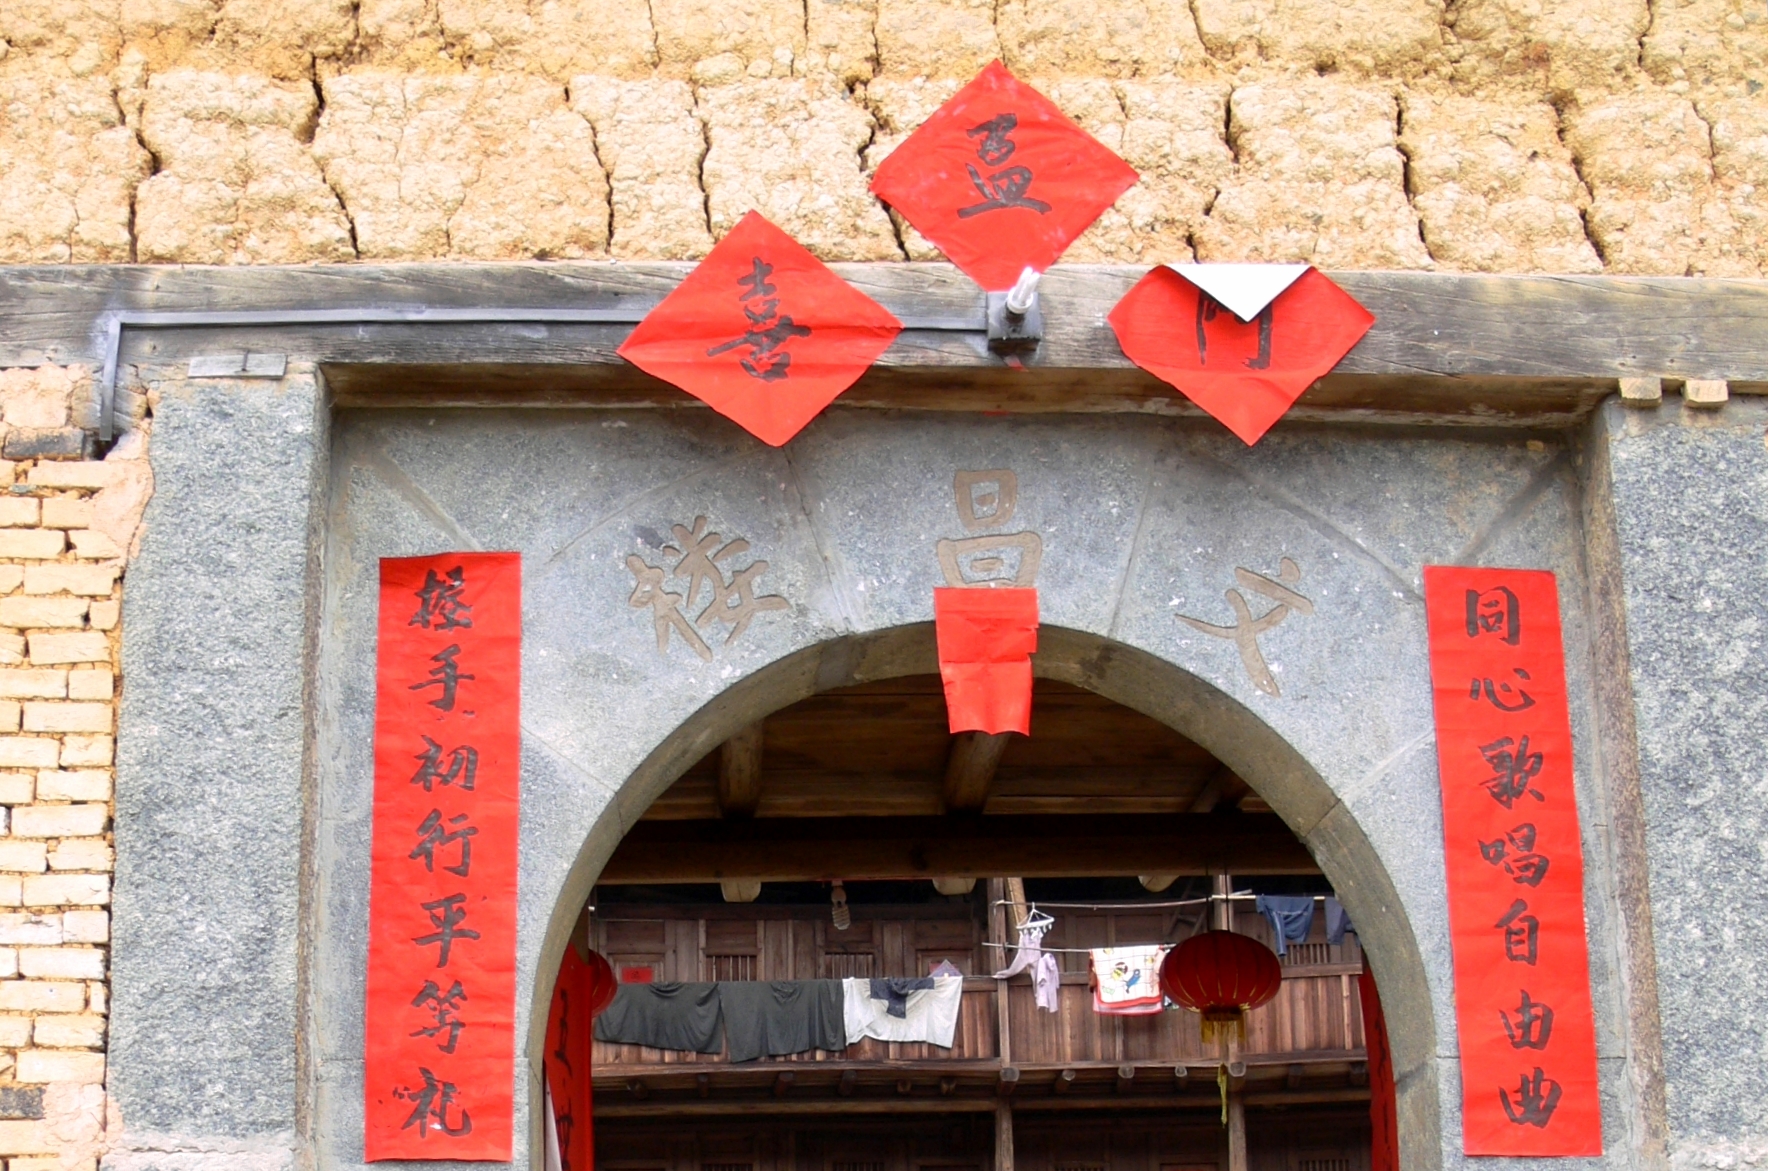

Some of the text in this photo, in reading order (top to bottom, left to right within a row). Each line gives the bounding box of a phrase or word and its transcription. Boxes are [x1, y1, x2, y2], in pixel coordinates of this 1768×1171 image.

[706, 255, 812, 383] 喜
[1464, 585, 1564, 1128] 同心歌唱自由曲
